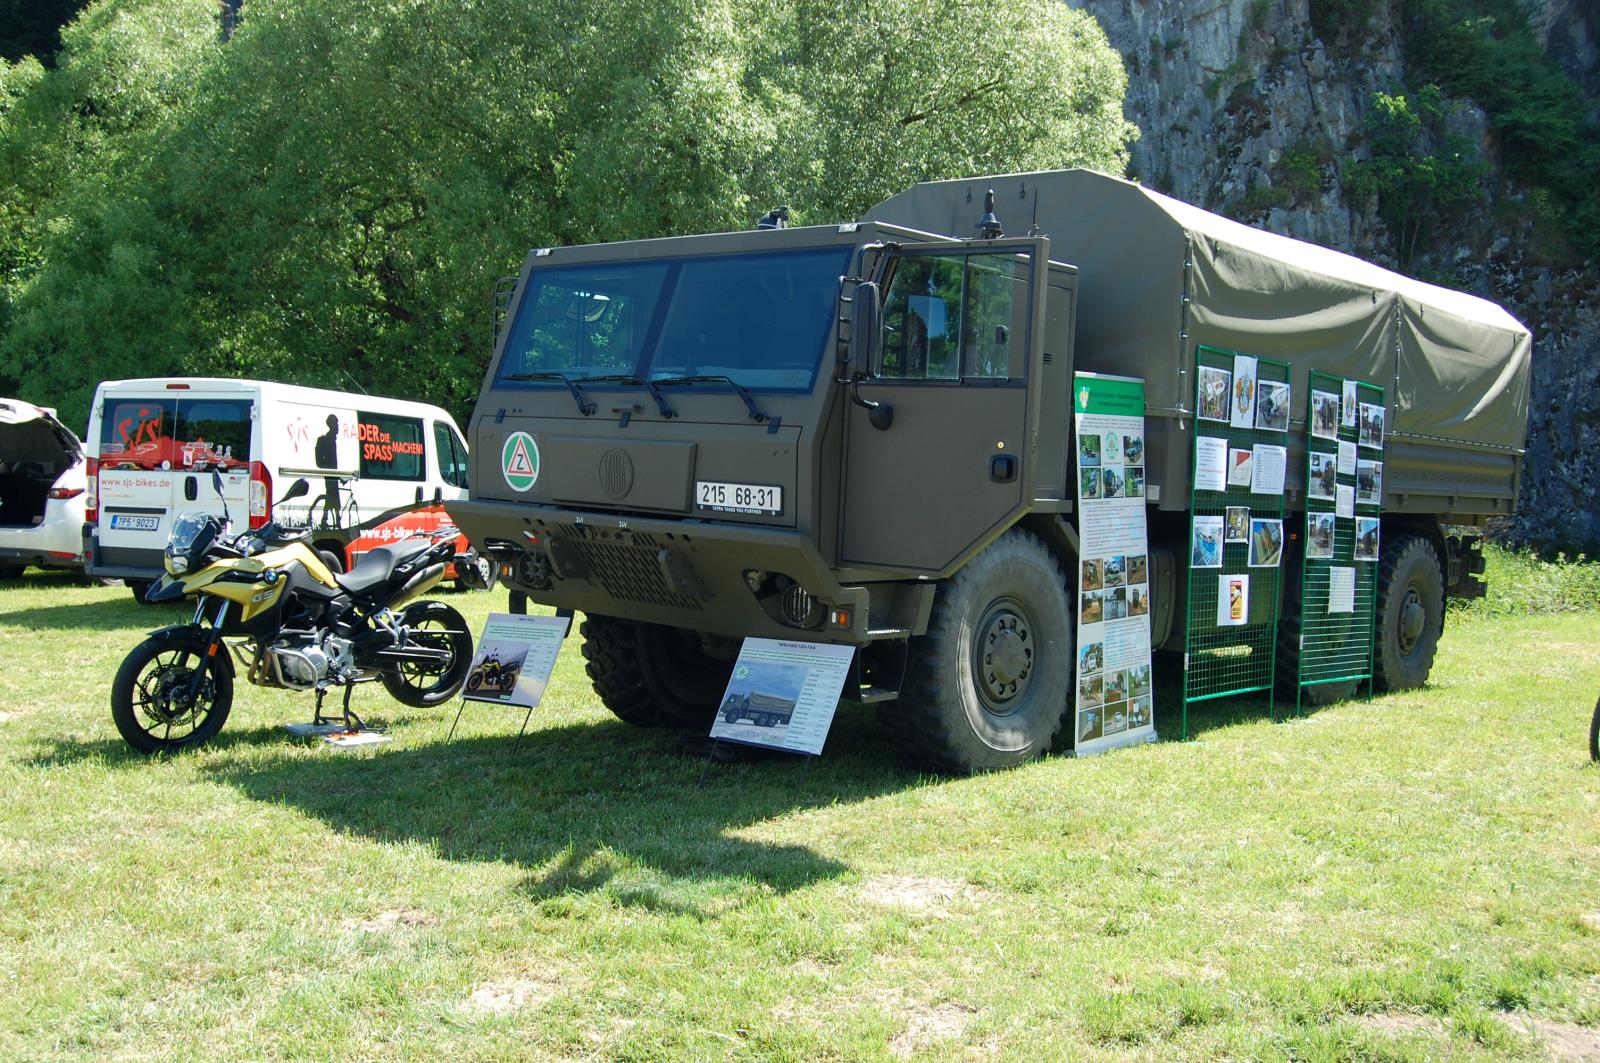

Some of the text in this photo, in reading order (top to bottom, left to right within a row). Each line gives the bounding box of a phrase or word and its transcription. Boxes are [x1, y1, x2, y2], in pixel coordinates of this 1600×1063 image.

[380, 432, 391, 443] DIE
[363, 441, 423, 461] SPASS MACHEN!
[516, 453, 524, 470] Z
[101, 477, 171, 488] www.sjs-bikes.de
[702, 484, 774, 508] 215 68-31
[117, 517, 155, 528] 7P5 9023
[359, 526, 425, 541] www.sjs-bikesde
